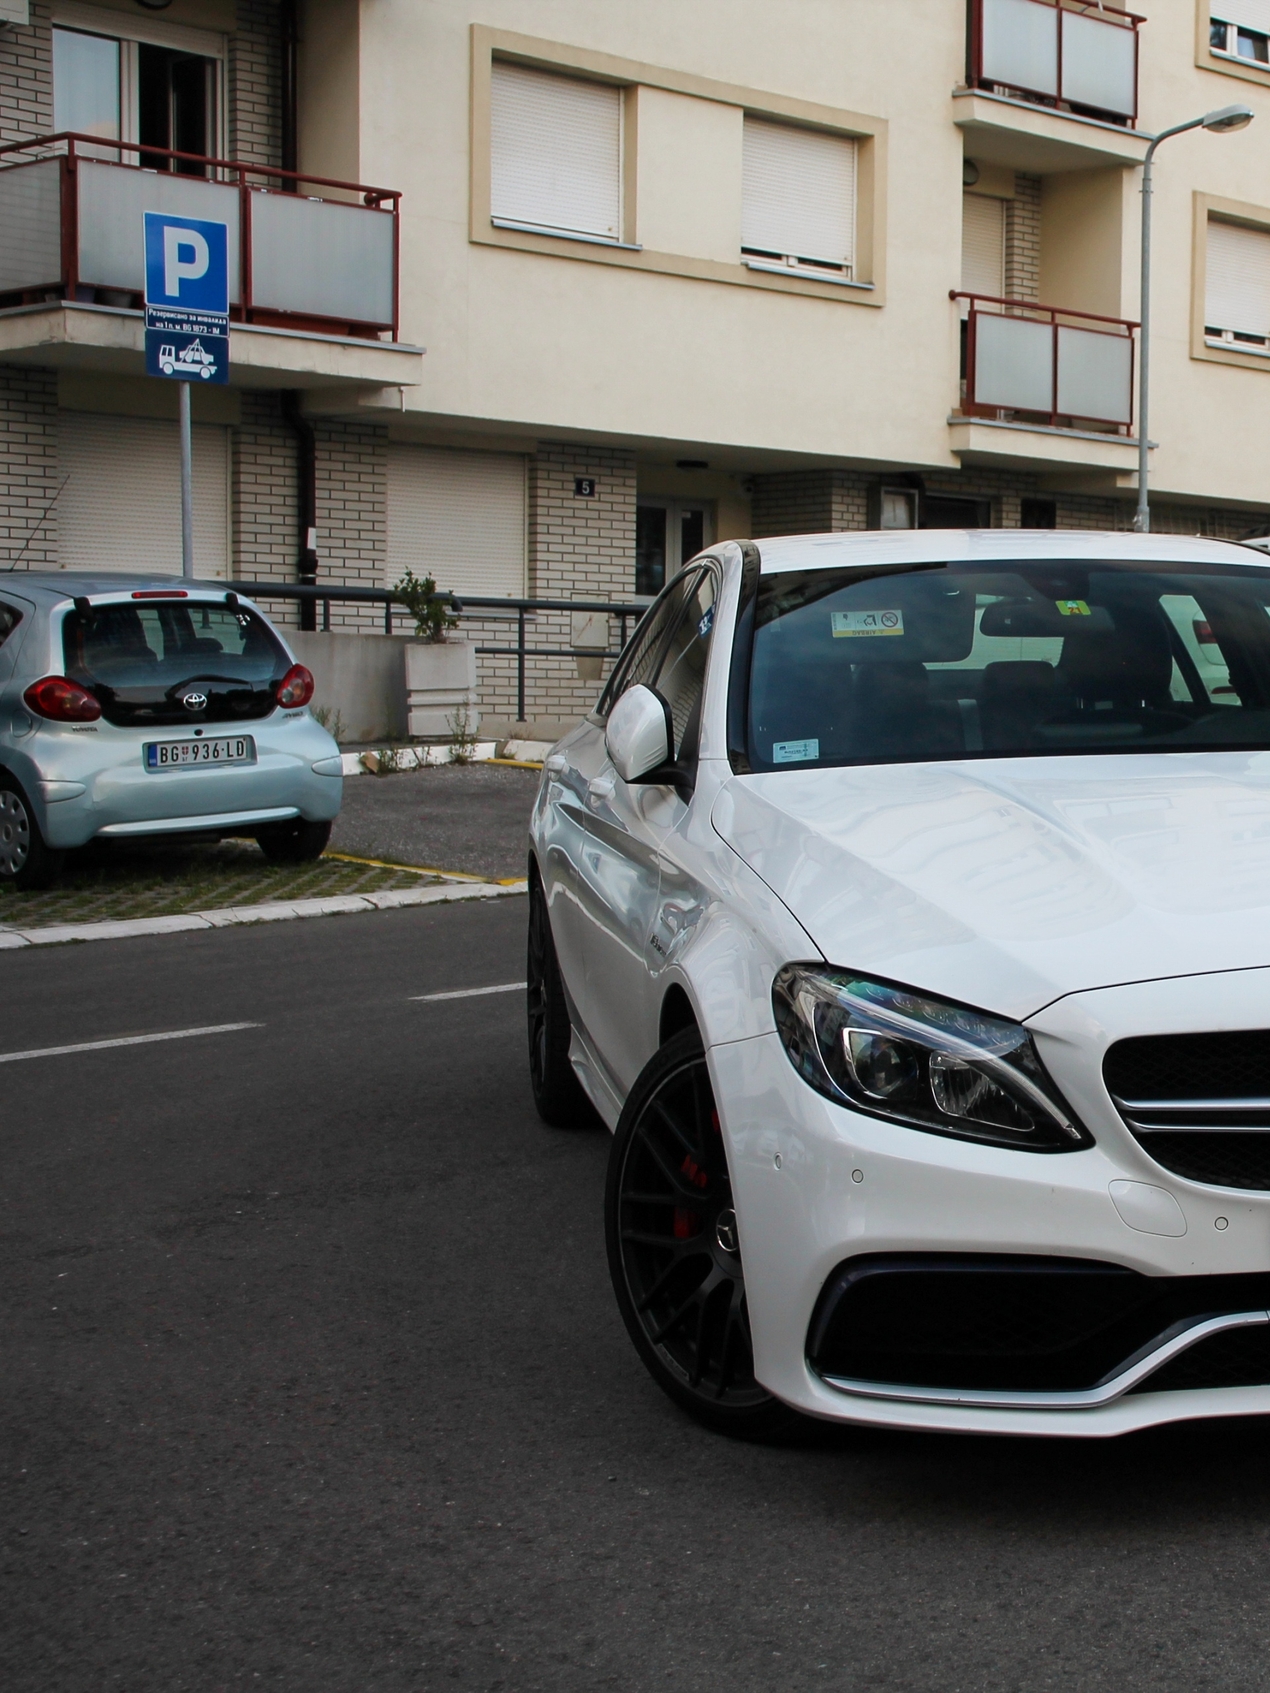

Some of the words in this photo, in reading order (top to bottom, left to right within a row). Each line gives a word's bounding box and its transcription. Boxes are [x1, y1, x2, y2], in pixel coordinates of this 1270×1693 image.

[164, 225, 209, 297] P
[582, 481, 590, 494] 5
[160, 746, 179, 763] BG
